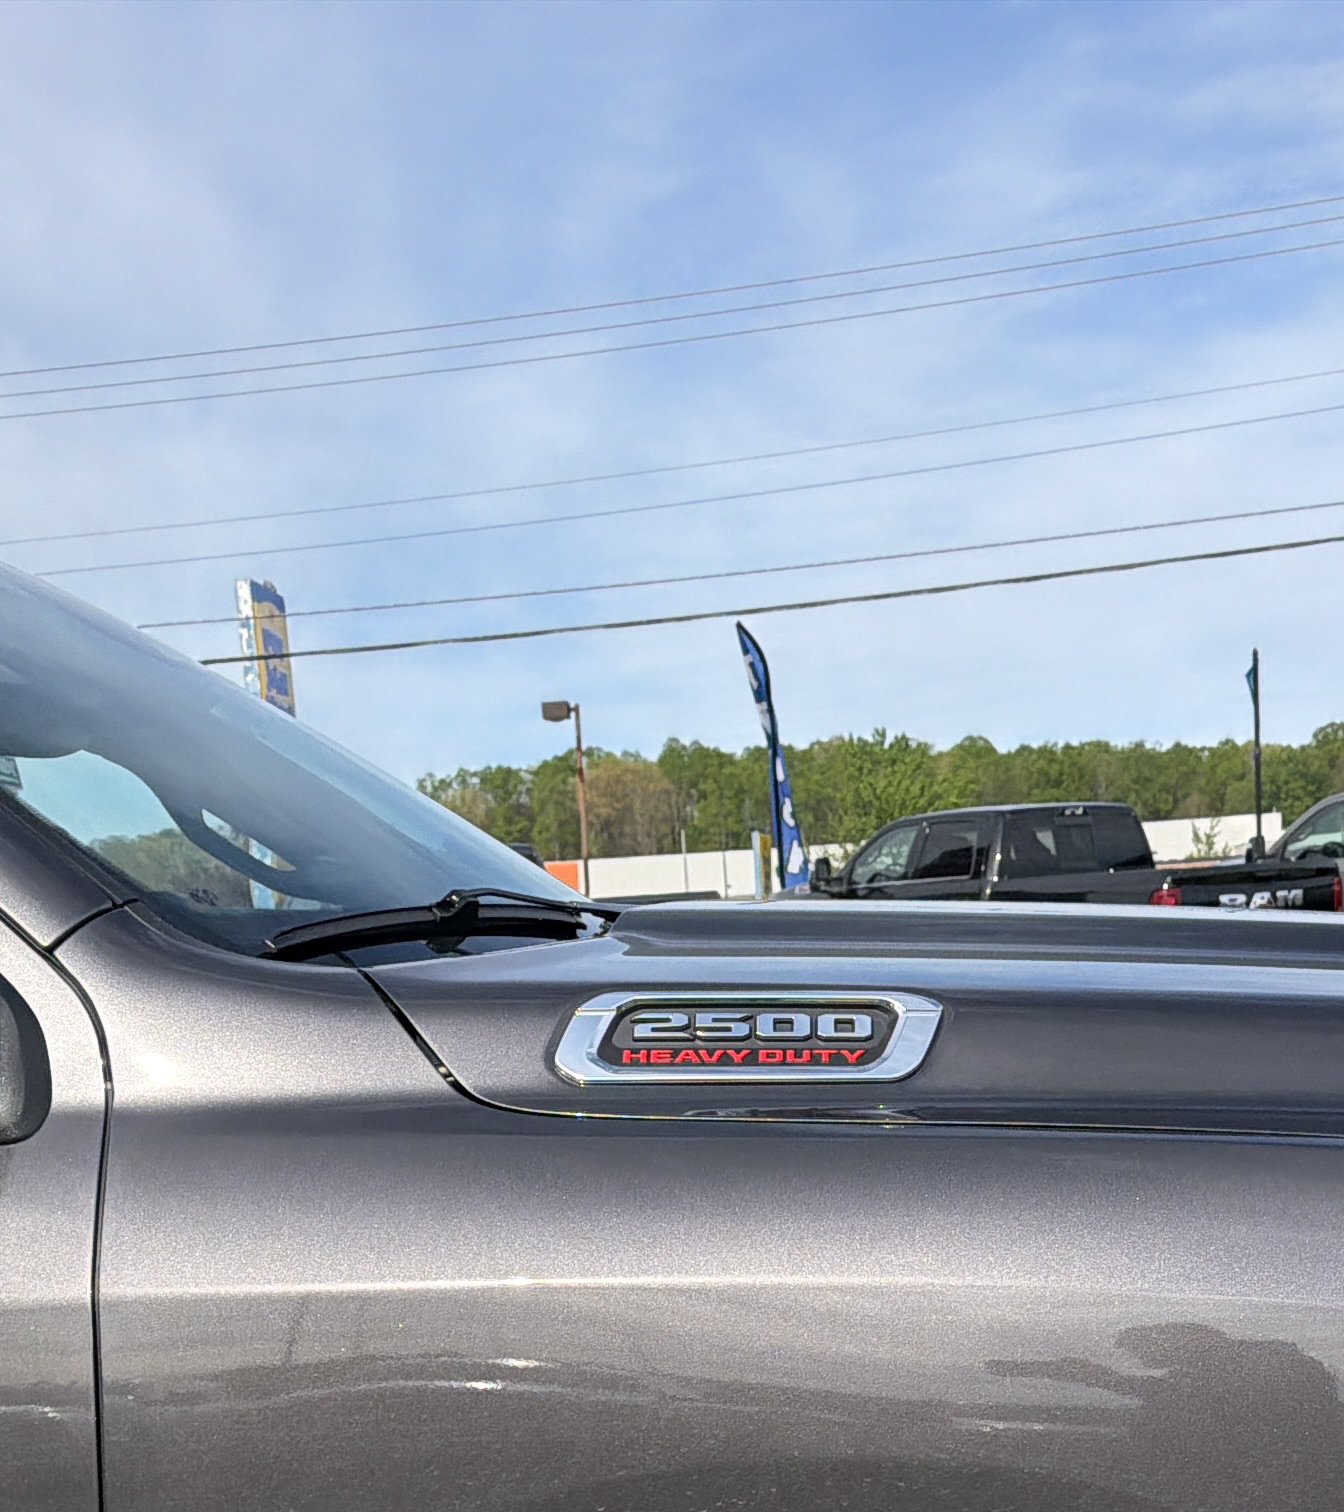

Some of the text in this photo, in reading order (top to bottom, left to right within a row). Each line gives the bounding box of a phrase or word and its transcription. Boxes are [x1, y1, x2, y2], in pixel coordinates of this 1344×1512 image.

[1218, 888, 1304, 910] RAM
[629, 1011, 874, 1041] 2500
[621, 1048, 866, 1065] HEAVY DUTY
